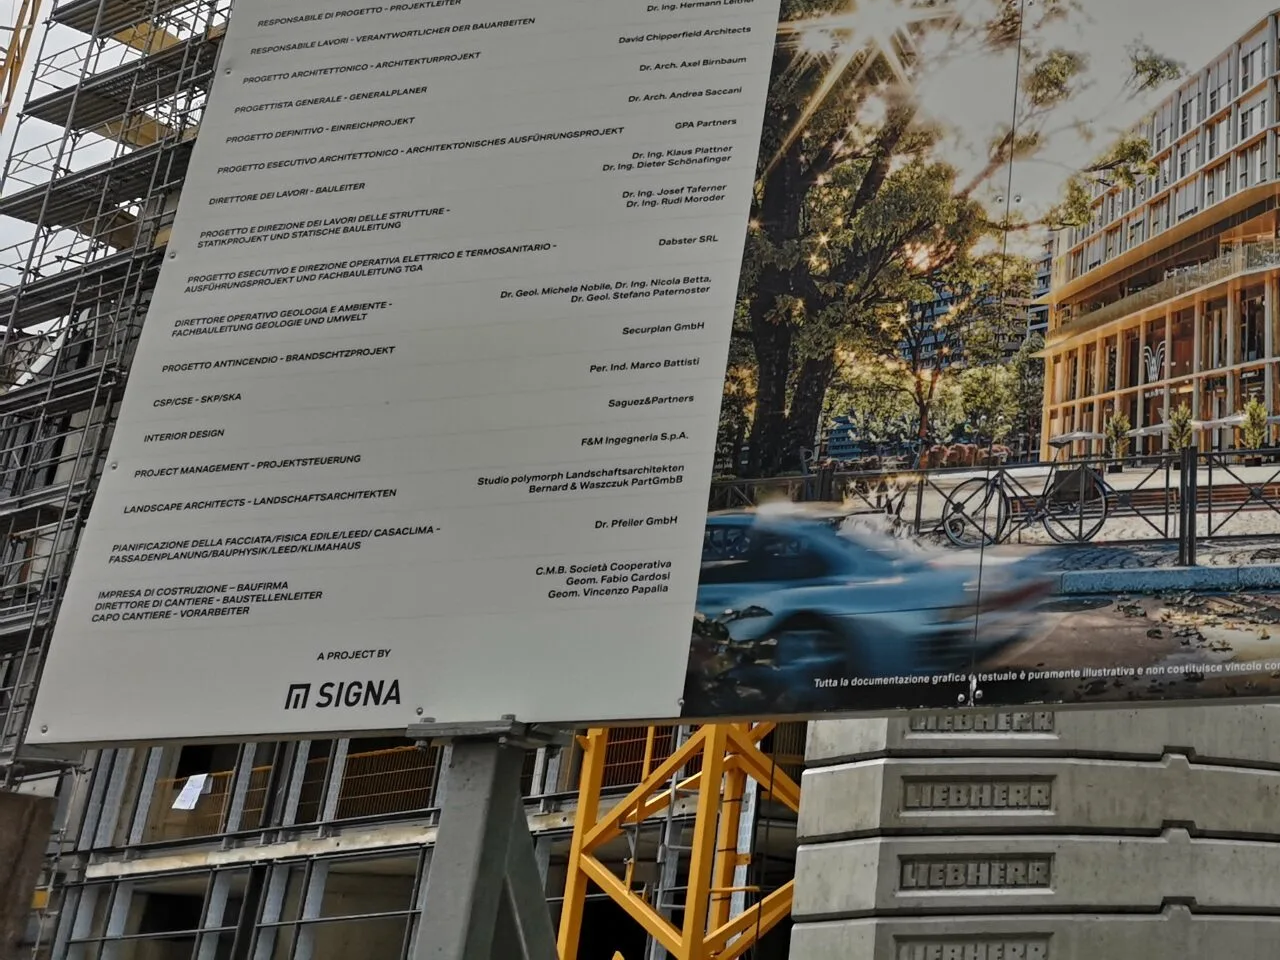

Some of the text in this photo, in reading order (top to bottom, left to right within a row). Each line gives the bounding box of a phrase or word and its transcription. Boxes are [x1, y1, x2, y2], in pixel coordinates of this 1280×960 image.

[679, 0, 722, 9] Hermann
[257, 13, 324, 27] RESPONSABILE
[335, 6, 383, 18] PROGETTO
[250, 17, 536, 55] RESPONSABILE VERANTWORTLICHER BAUARBEITEN
[645, 26, 752, 42] Chipperfield Architects
[242, 51, 481, 85] PROGETTO ARCHITETTONICO ARCHITEKTURPROJEKT
[653, 57, 747, 70] Arch. Birnbaum
[234, 86, 428, 114] PROGETTISTA GENERALE GENERALPLANER
[642, 86, 743, 101] Arch. Andrea Saccani
[225, 116, 416, 144] PROGETTO DEFINITIVO EINREICHPROJEKT
[696, 119, 737, 128] Partners
[216, 137, 507, 174] PROGETTO ESECUTIVO ARCHITETTONICO ARCHITEKTONISCHES
[666, 146, 733, 157] Klaus Plattner
[636, 161, 666, 169] Dieter
[208, 182, 366, 206] DIRETTORE LAVORI BAULEITER
[656, 184, 727, 196] Josef Taferner
[684, 194, 726, 203] Moroder
[199, 207, 445, 239] PROGETTO DIREZIONE LAVORI DELLE STRUTTURE
[197, 221, 402, 249] STATIKPROJEKT STATISCHE BAULEITUNG
[658, 237, 698, 246] Dabster
[187, 242, 551, 283] PROGETTO ESECUTIVO DIREZIONE OPERATIVA ELETTRICO TERMOSANITARIO
[318, 266, 402, 281] FACHBAULEITUNG
[515, 277, 681, 298] Geol. Michele Nicola
[586, 286, 711, 302] Geol. Stefano Paternoster
[174, 301, 387, 328] DIRETTORE OPERATIVO GEOLOGIA AMBIENTE
[171, 312, 368, 337] FACHBAULEITUNG GEOLOGIE UMWELT
[622, 321, 705, 335] Securplan GmbH
[161, 355, 278, 373] PROGETTO ANTINCENDIO
[630, 357, 700, 370] Marco Battisti
[143, 428, 225, 443] INTERIOR DESIGN
[605, 431, 689, 446] Ingegneria S.p.A.
[134, 454, 361, 478] PROJECT MANAGEMENT PROJEKTSTEUERUNG
[477, 465, 685, 486] Studio polymorph Landschaftsarchitekten
[528, 479, 629, 494] Bernard Waszczuk
[123, 488, 397, 514] LANDSCAPE ARCHITECTS LANDSCHAFTSARCHITEKTEN
[645, 515, 678, 526] GmbH
[111, 525, 434, 553] PIANIFICAZIONE DELLA CASACLIMA
[609, 560, 672, 571] Cooperativa
[565, 571, 671, 586] Geom. Fabio Cardosi
[97, 581, 289, 599] IMPRESA COSTRUZIONE BAUFIRMA
[547, 587, 630, 599] Geom. Vincenzo
[94, 590, 323, 611] DIRETTORE CANTIERE BAUSTELLENLEITER
[91, 606, 250, 623] CAPO CANTIERE VORARBEITER
[326, 649, 377, 660] PROJECT
[814, 678, 838, 688] Tutta
[851, 675, 930, 687] documentazione
[932, 674, 966, 686] grafica
[978, 671, 1017, 682] testuale
[1028, 669, 1081, 681] puramente
[1082, 666, 1135, 677] illustrativa
[1146, 666, 1165, 675] non
[1167, 663, 1223, 674] costituisce
[315, 679, 401, 708] SIGNA
[906, 783, 1050, 807] LIEBHERR
[903, 862, 1050, 887] LIEBHERR
